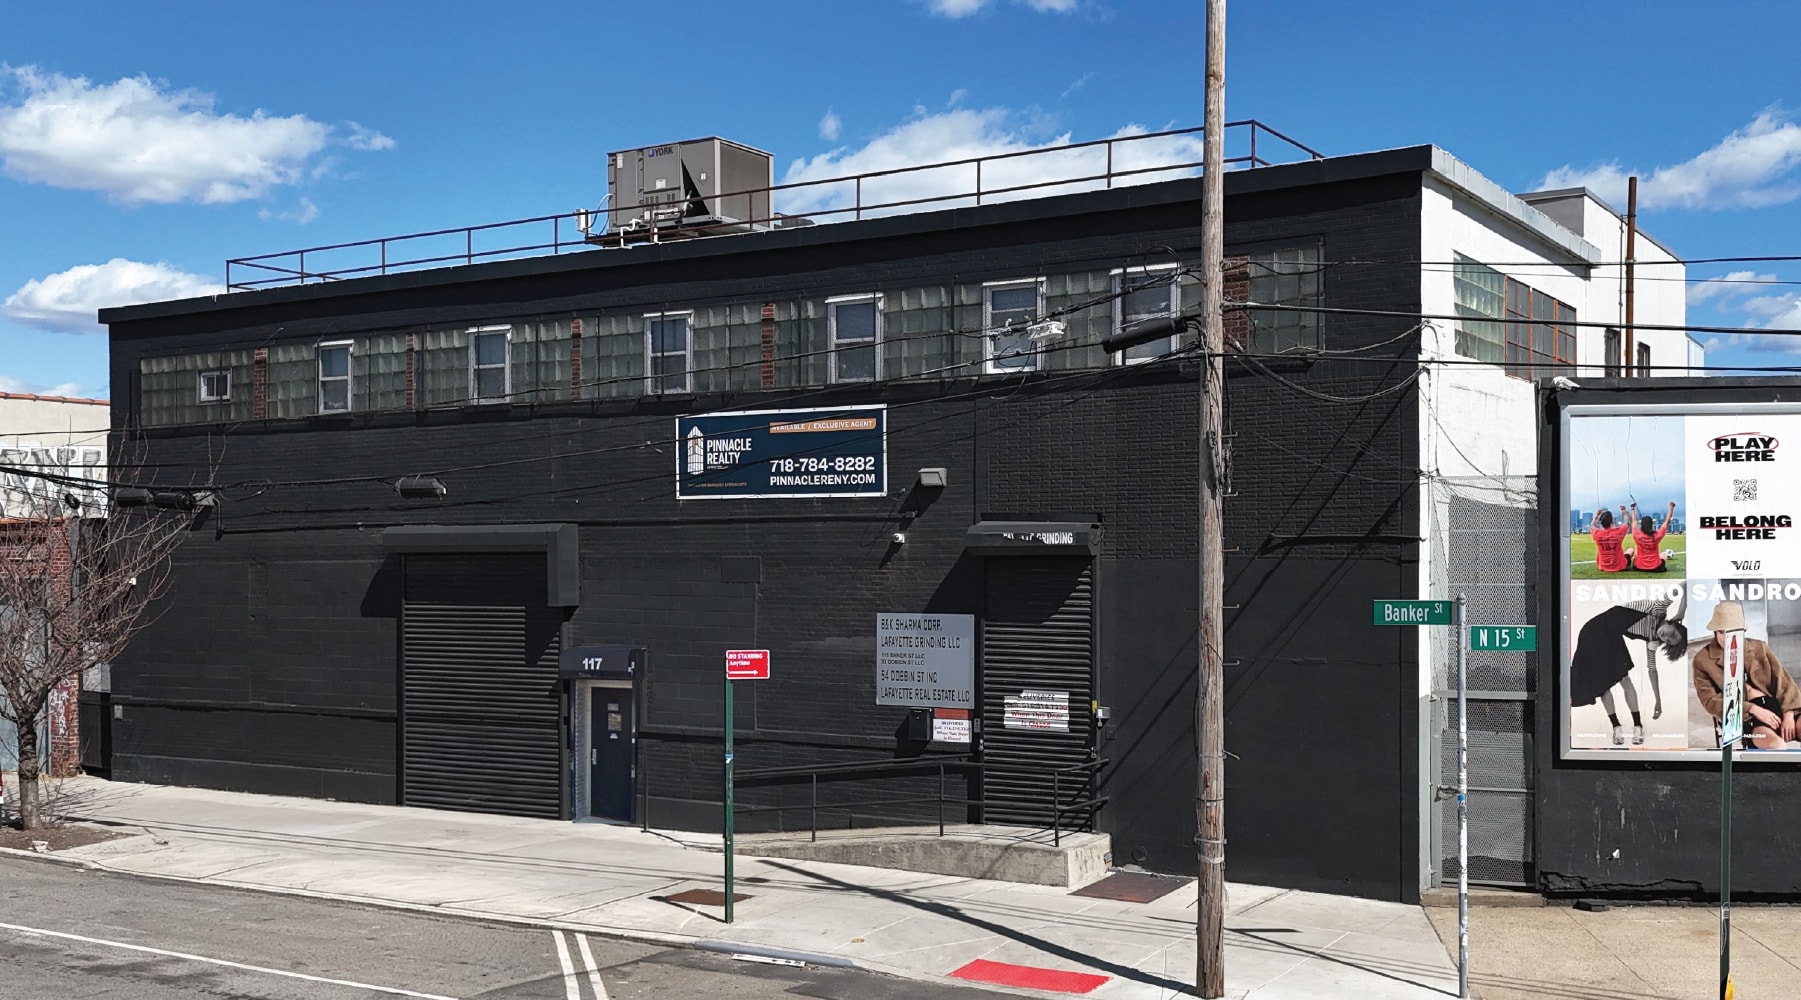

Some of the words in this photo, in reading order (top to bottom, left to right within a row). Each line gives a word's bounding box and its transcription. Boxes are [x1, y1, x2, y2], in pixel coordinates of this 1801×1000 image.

[655, 146, 674, 157] YORK
[850, 420, 873, 428] AGENT
[706, 438, 752, 452] PINNACLE
[1714, 437, 1775, 450] PLAY
[706, 452, 741, 465] REALTY
[1715, 450, 1775, 462] HERE
[769, 456, 875, 473] 718-784-8282
[769, 473, 876, 486] PINNACLERENY.COM
[1699, 515, 1792, 529] BELONG
[1715, 528, 1776, 540] HERE
[1730, 560, 1761, 571] VOLO
[1576, 584, 1684, 602] SANDRO
[1692, 583, 1801, 601] SANDRO
[1384, 603, 1430, 622] Banker
[1434, 603, 1443, 614] St
[895, 619, 921, 631] SHARMA
[923, 619, 943, 631] CORP.
[881, 636, 913, 648] LAFAYETTE
[915, 636, 946, 649] GRINDING
[948, 637, 960, 649] LLC
[1479, 629, 1488, 647] N
[1494, 629, 1510, 648] 15
[1516, 628, 1525, 639] St
[582, 657, 603, 671] 117
[881, 669, 890, 681] 54
[890, 670, 916, 683] DOBBIN
[917, 671, 925, 683] ST
[926, 671, 938, 684] INC
[881, 686, 913, 700] LAFAYETTE
[915, 688, 931, 701] REAL
[932, 689, 956, 702] ESTATE
[957, 690, 970, 703] LLC
